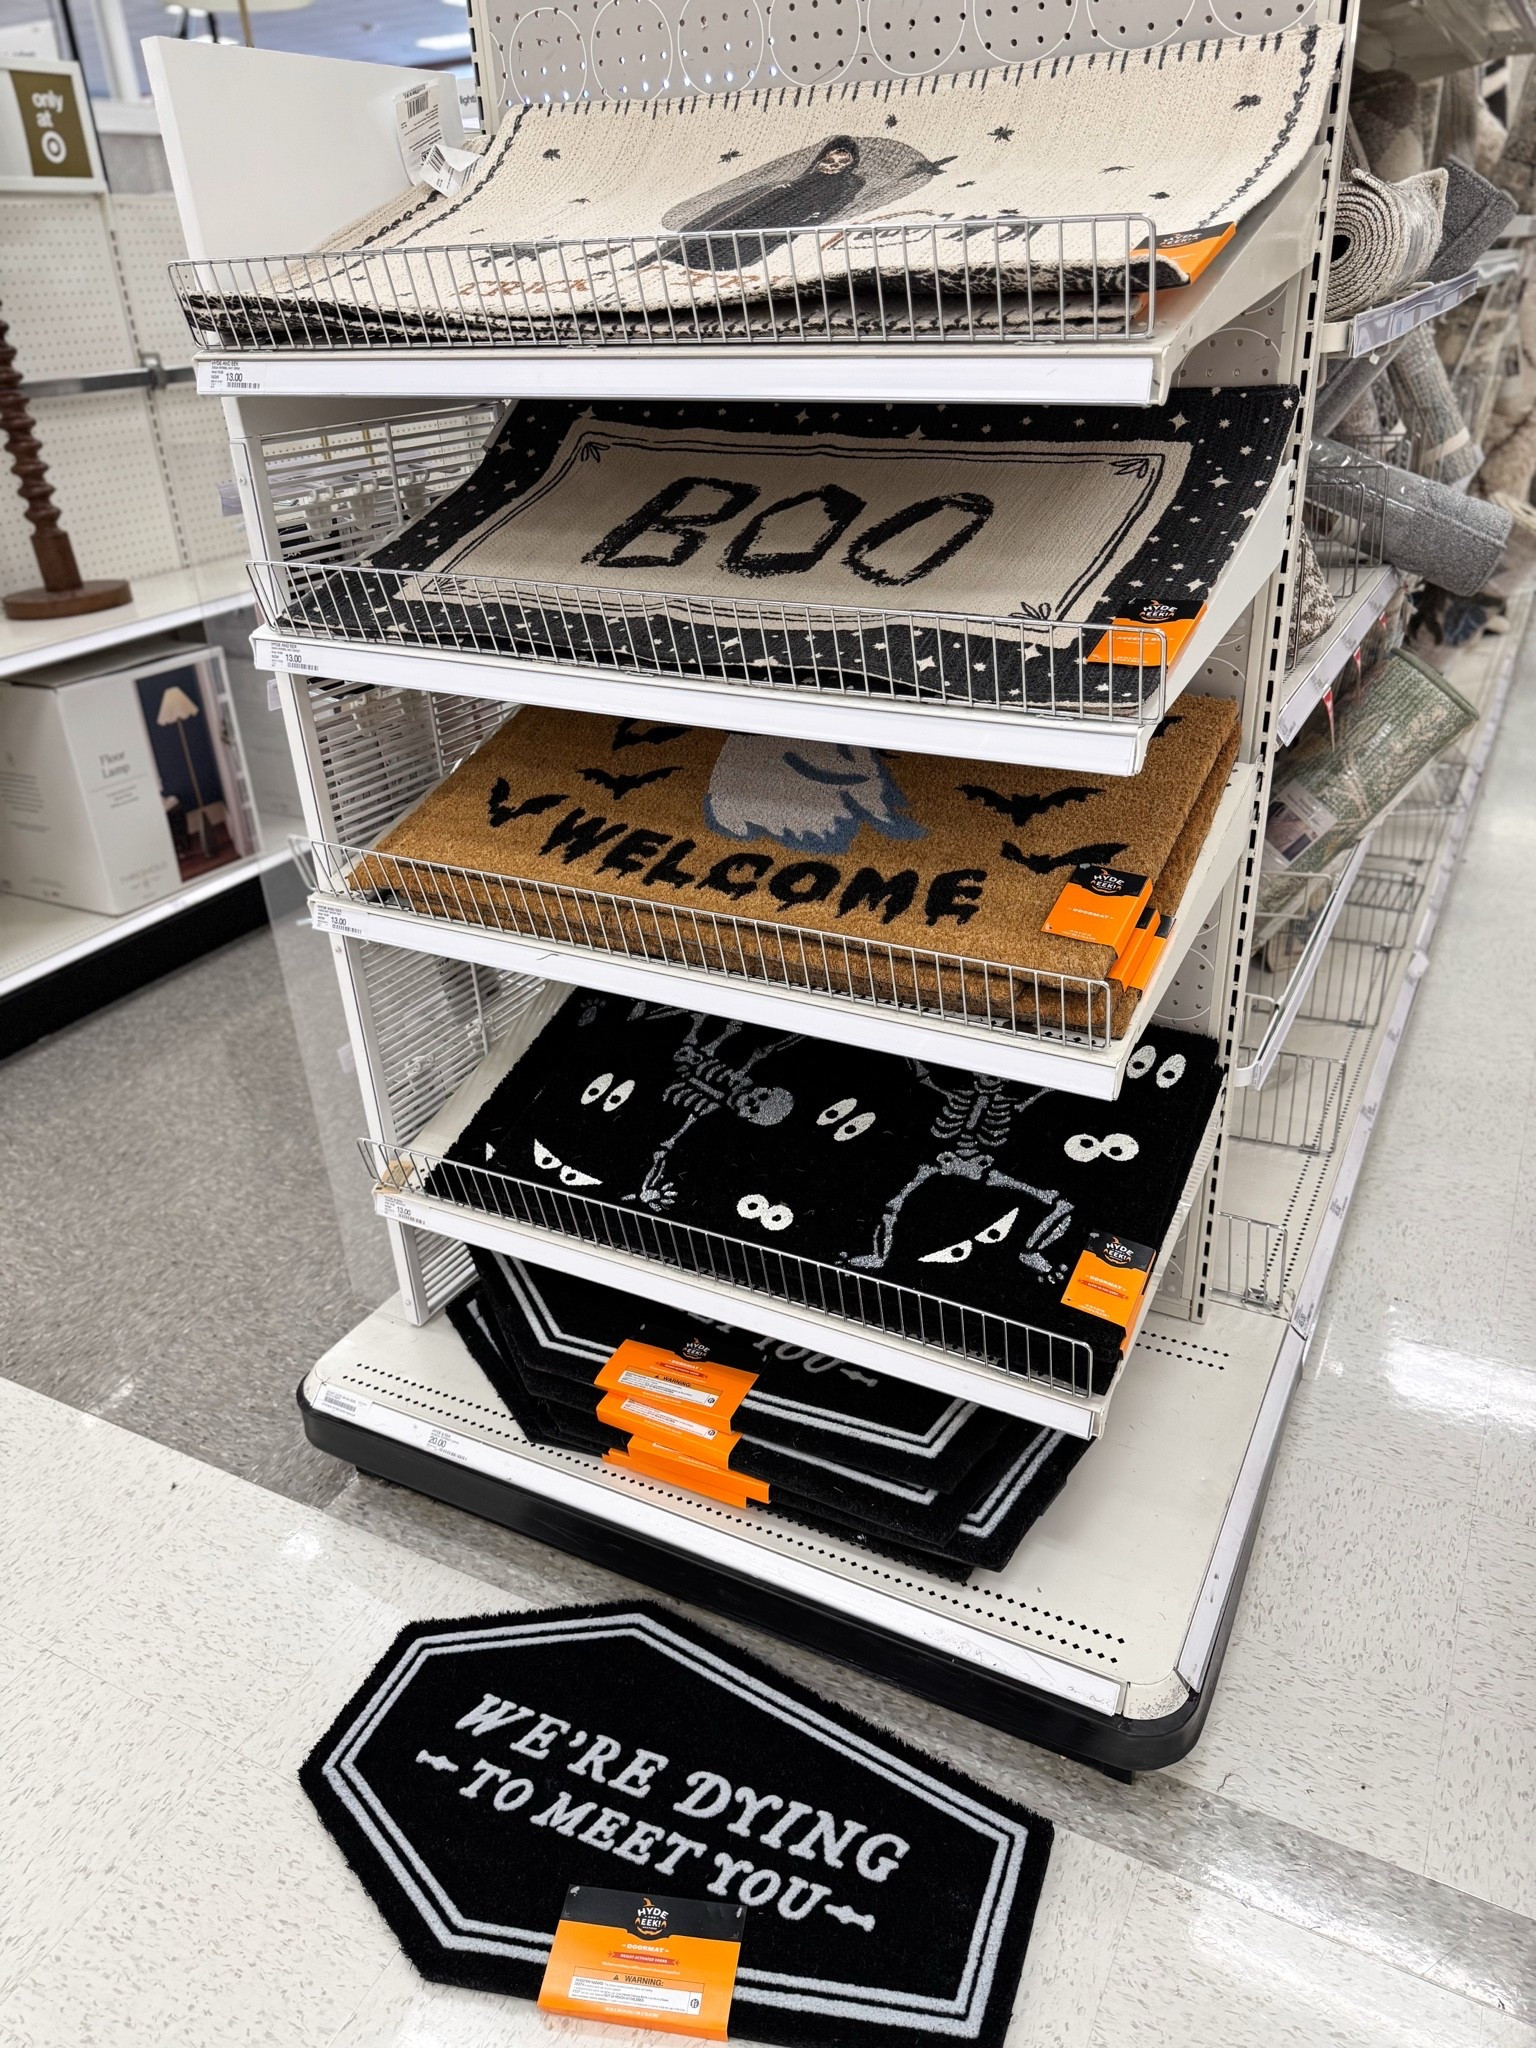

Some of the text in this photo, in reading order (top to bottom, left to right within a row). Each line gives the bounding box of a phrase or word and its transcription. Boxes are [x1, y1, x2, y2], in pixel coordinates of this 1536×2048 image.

[32, 90, 63, 113] only
[36, 110, 54, 128] at
[226, 372, 243, 382] 13.00
[580, 476, 994, 586] BOO
[1143, 604, 1178, 612] HYDE
[285, 654, 302, 663] 13.00
[99, 751, 126, 766] Floor
[101, 763, 131, 779] Lamp
[538, 807, 988, 926] WELCOME
[1093, 874, 1125, 886] HYDE
[1072, 907, 1110, 919] DOORMAT
[331, 916, 346, 926] 13.00
[396, 1206, 412, 1216] 13.00
[1106, 1243, 1134, 1257] HYDE
[1089, 1275, 1123, 1290] DOORMAT
[686, 1342, 711, 1353] HYDE
[428, 1435, 447, 1448] 20.00
[454, 1693, 910, 1882] WE'RE DYING
[459, 1758, 832, 1921] TO MEET YOU
[637, 1907, 670, 1920] HYDE
[640, 1918, 661, 1928] EEK!
[626, 1943, 664, 1953] DOORMAT
[624, 1975, 665, 1987] WARNING:
